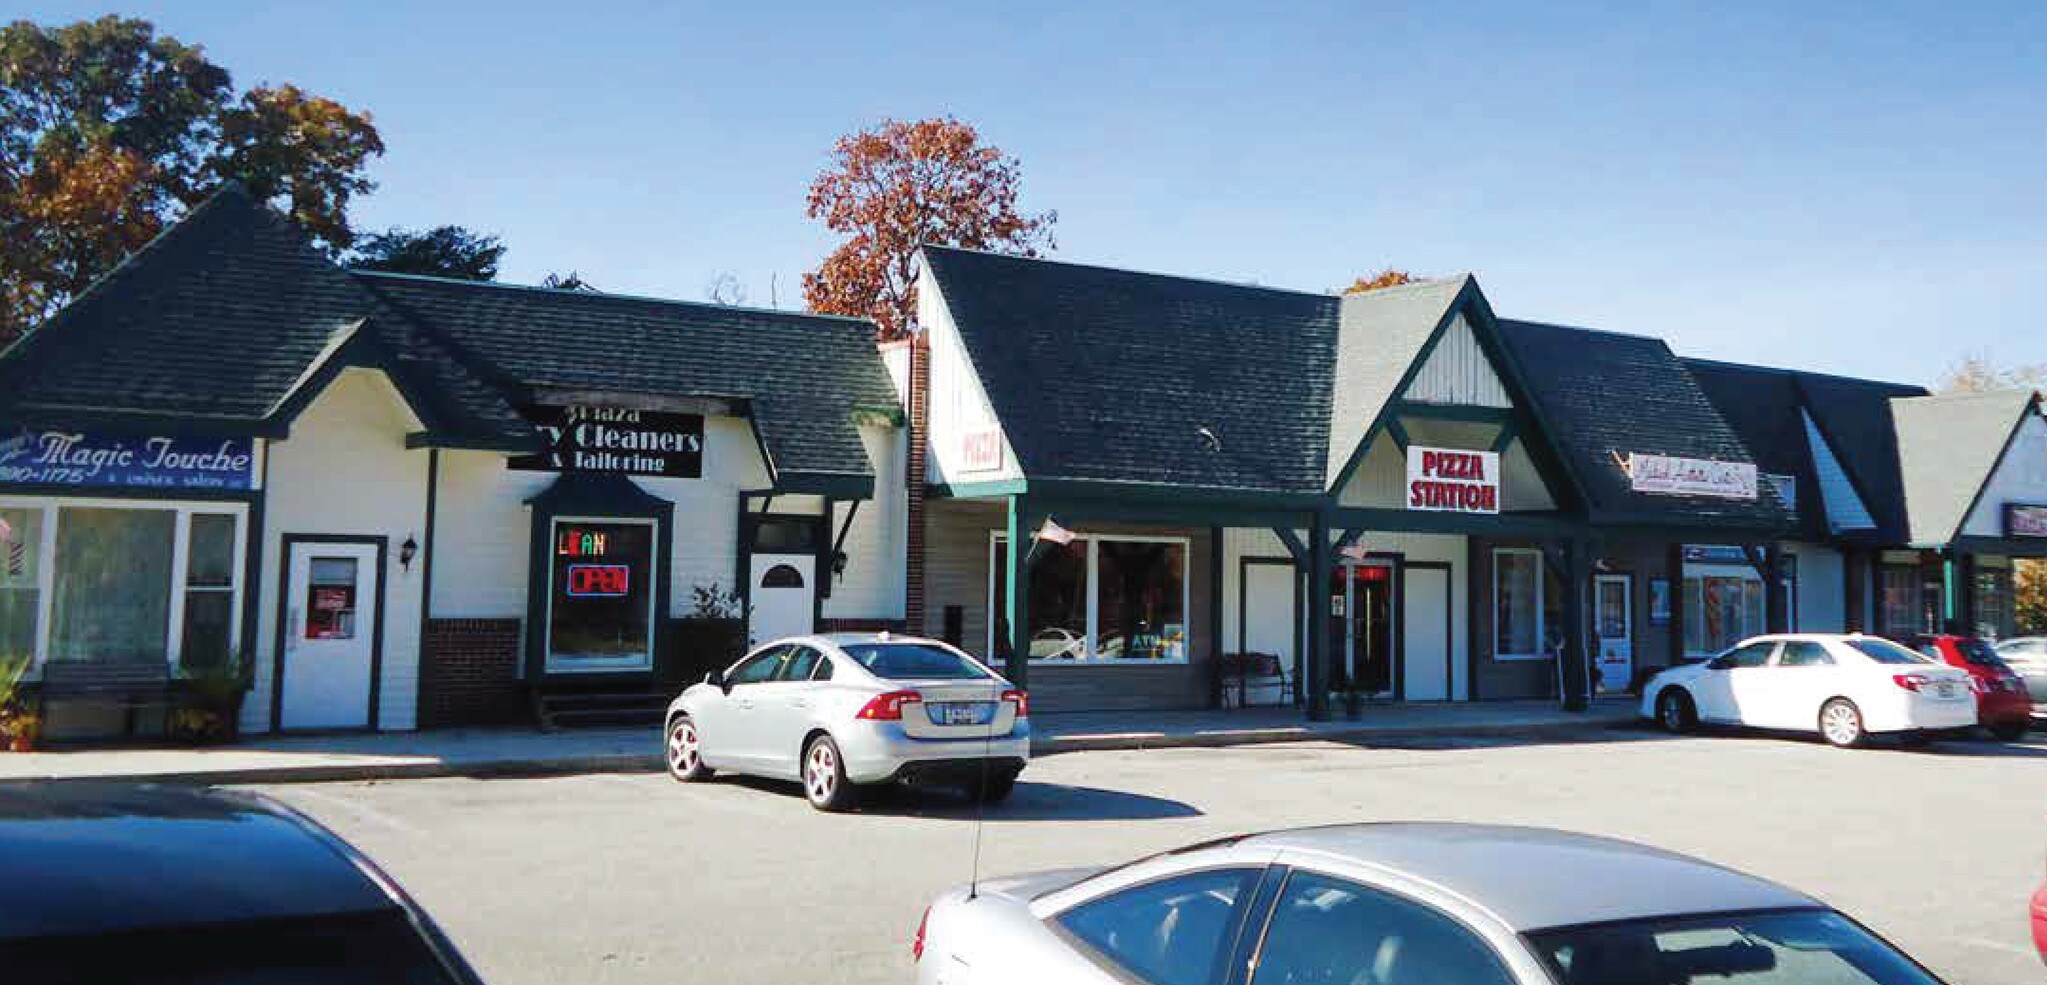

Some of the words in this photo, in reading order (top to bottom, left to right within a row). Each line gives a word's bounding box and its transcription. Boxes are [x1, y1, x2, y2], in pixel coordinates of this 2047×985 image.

[576, 423, 699, 452] Cleaners
[32, 431, 134, 477] Magic
[140, 436, 250, 471] Touche
[574, 450, 665, 472] Tailoring
[1421, 451, 1484, 480] PIZZA
[1410, 481, 1496, 511] STATION
[571, 567, 627, 593] OPEN
